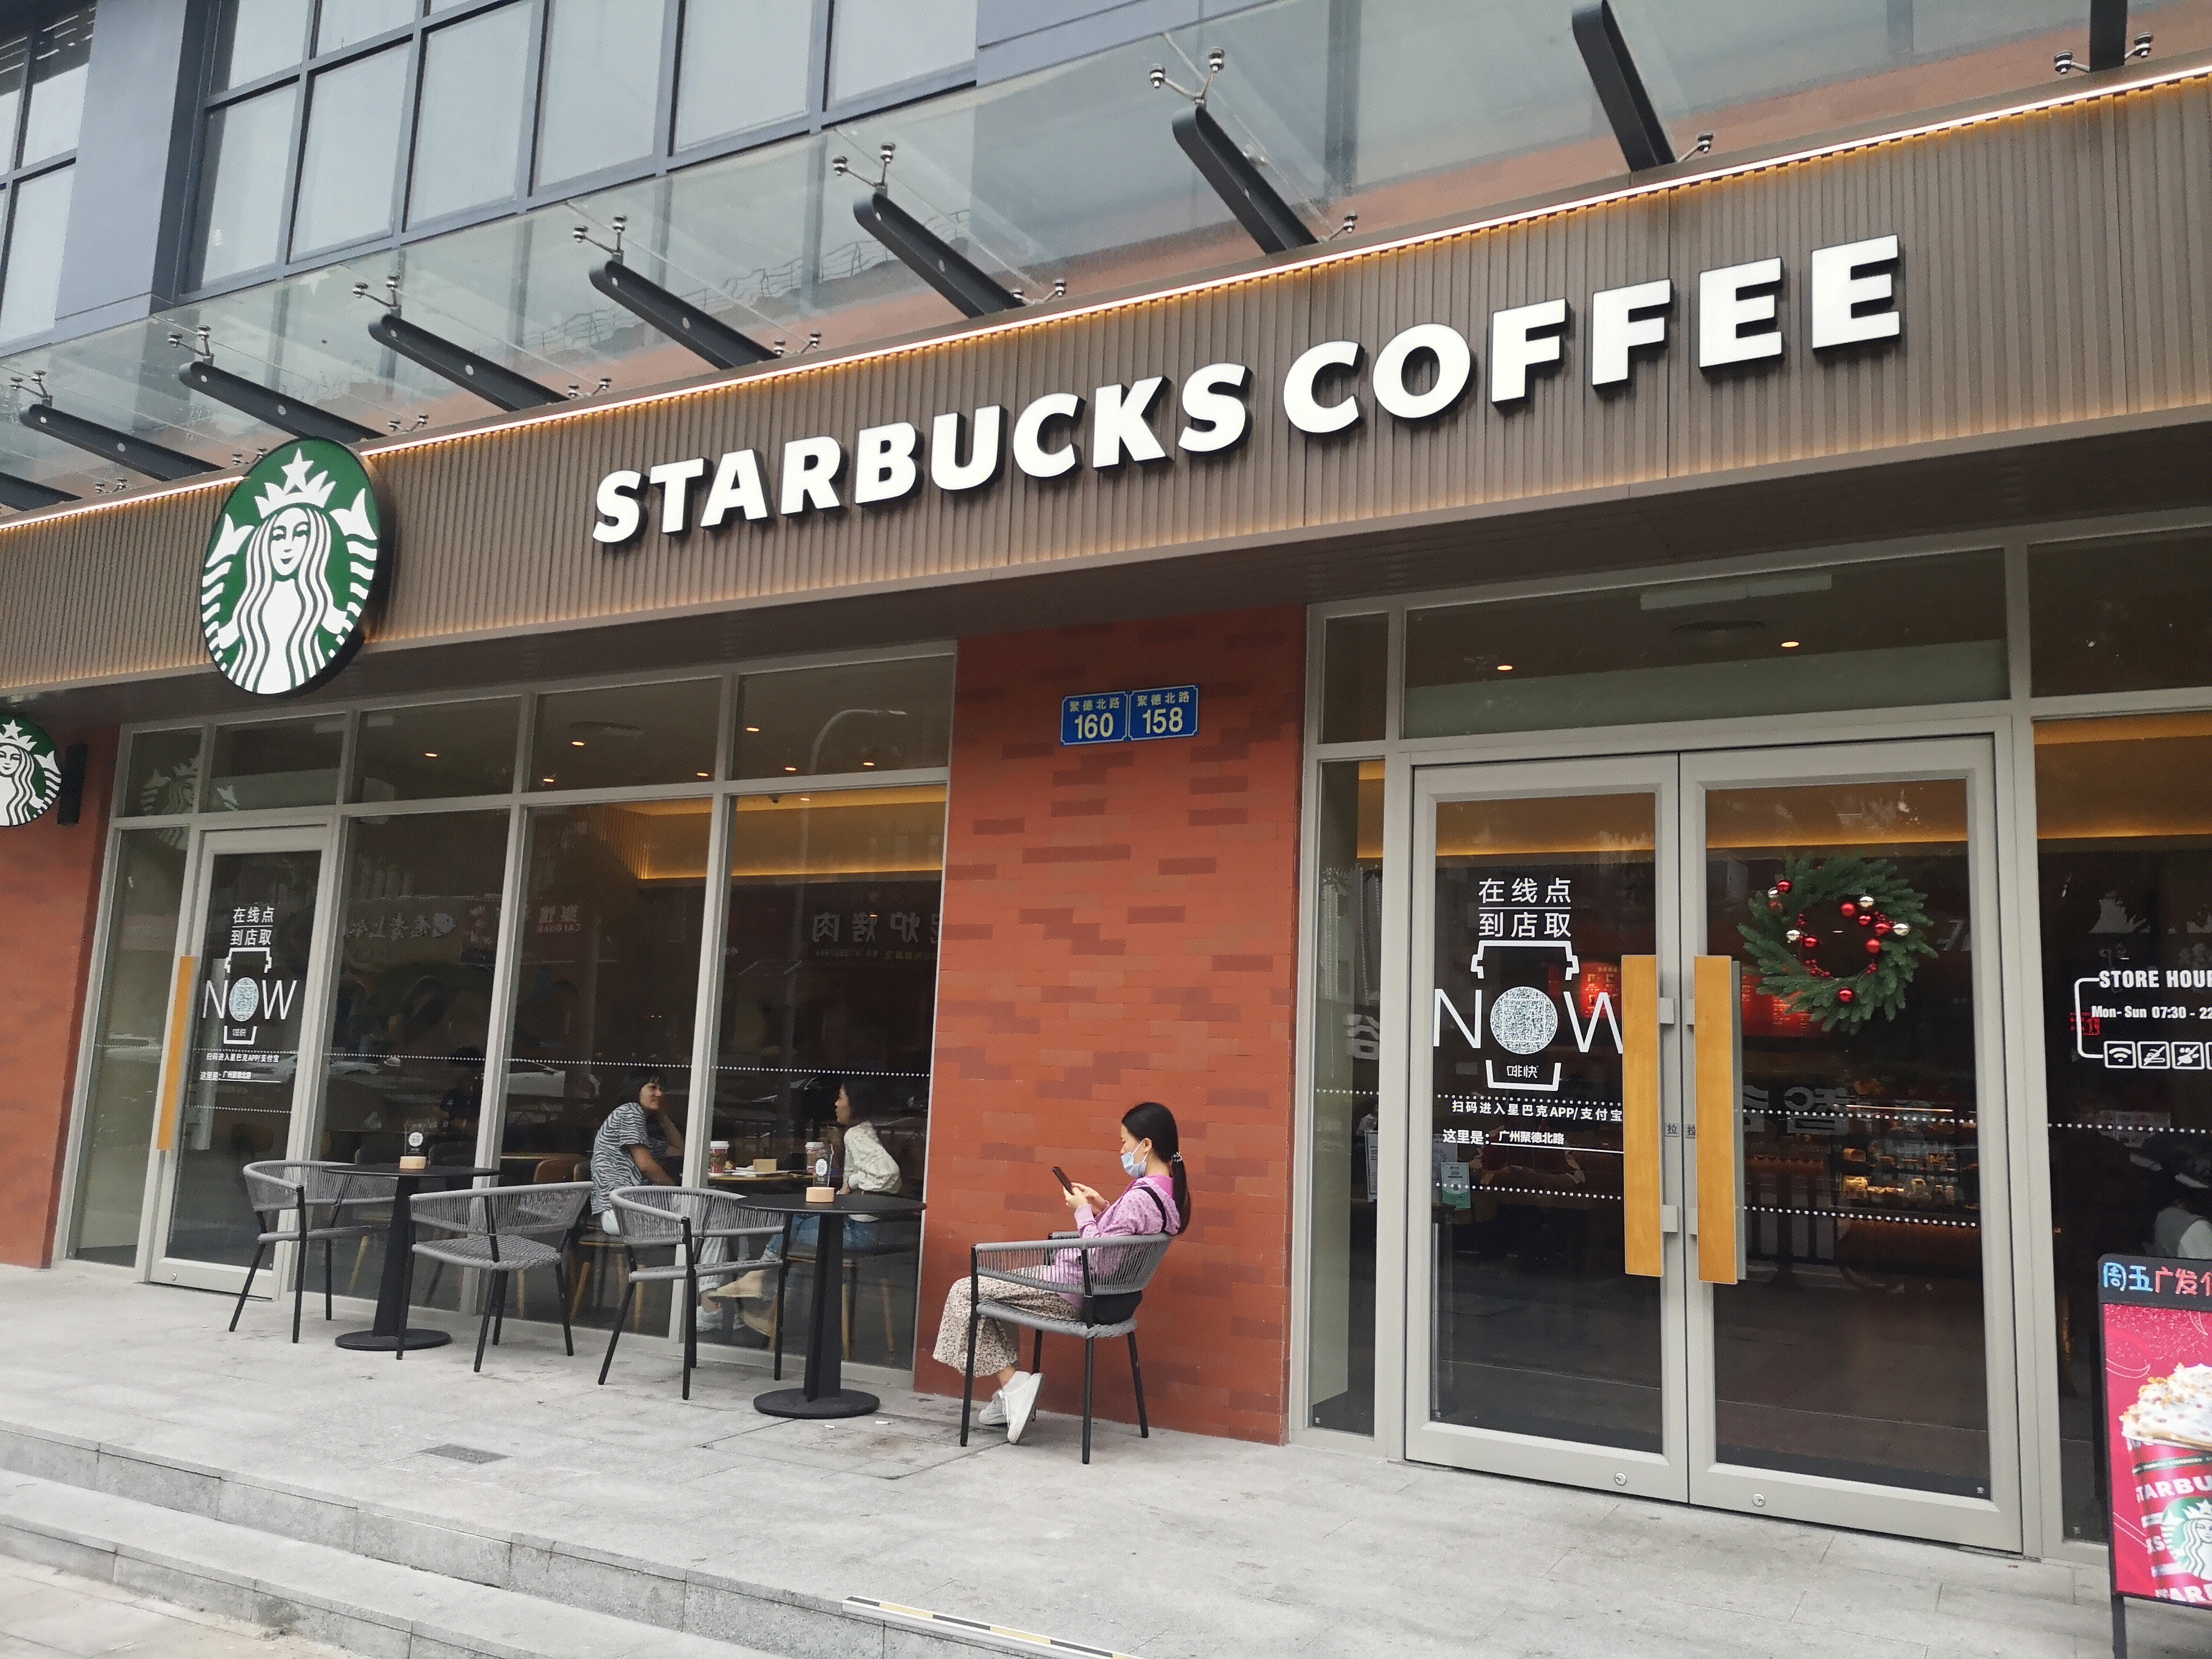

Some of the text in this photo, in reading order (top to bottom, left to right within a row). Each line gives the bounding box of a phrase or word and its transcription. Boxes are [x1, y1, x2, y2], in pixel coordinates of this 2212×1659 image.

[593, 234, 1900, 545] STARBUCKS COFFEE
[1069, 697, 1120, 713] 聚德北路
[1137, 691, 1190, 707] 聚德北路
[1074, 712, 1114, 740] 160
[1142, 706, 1183, 734] 158
[1478, 877, 1571, 904] 在线点
[232, 906, 275, 924] 在线点
[1478, 911, 1571, 938] 到店取
[229, 928, 272, 946] 到店取
[2099, 970, 2160, 988] STORE
[2124, 1005, 2147, 1018] Sun
[2152, 1006, 2187, 1019] 07:30
[1498, 1130, 1565, 1145] 广州聚德北路
[1667, 1124, 1678, 1134] 拉
